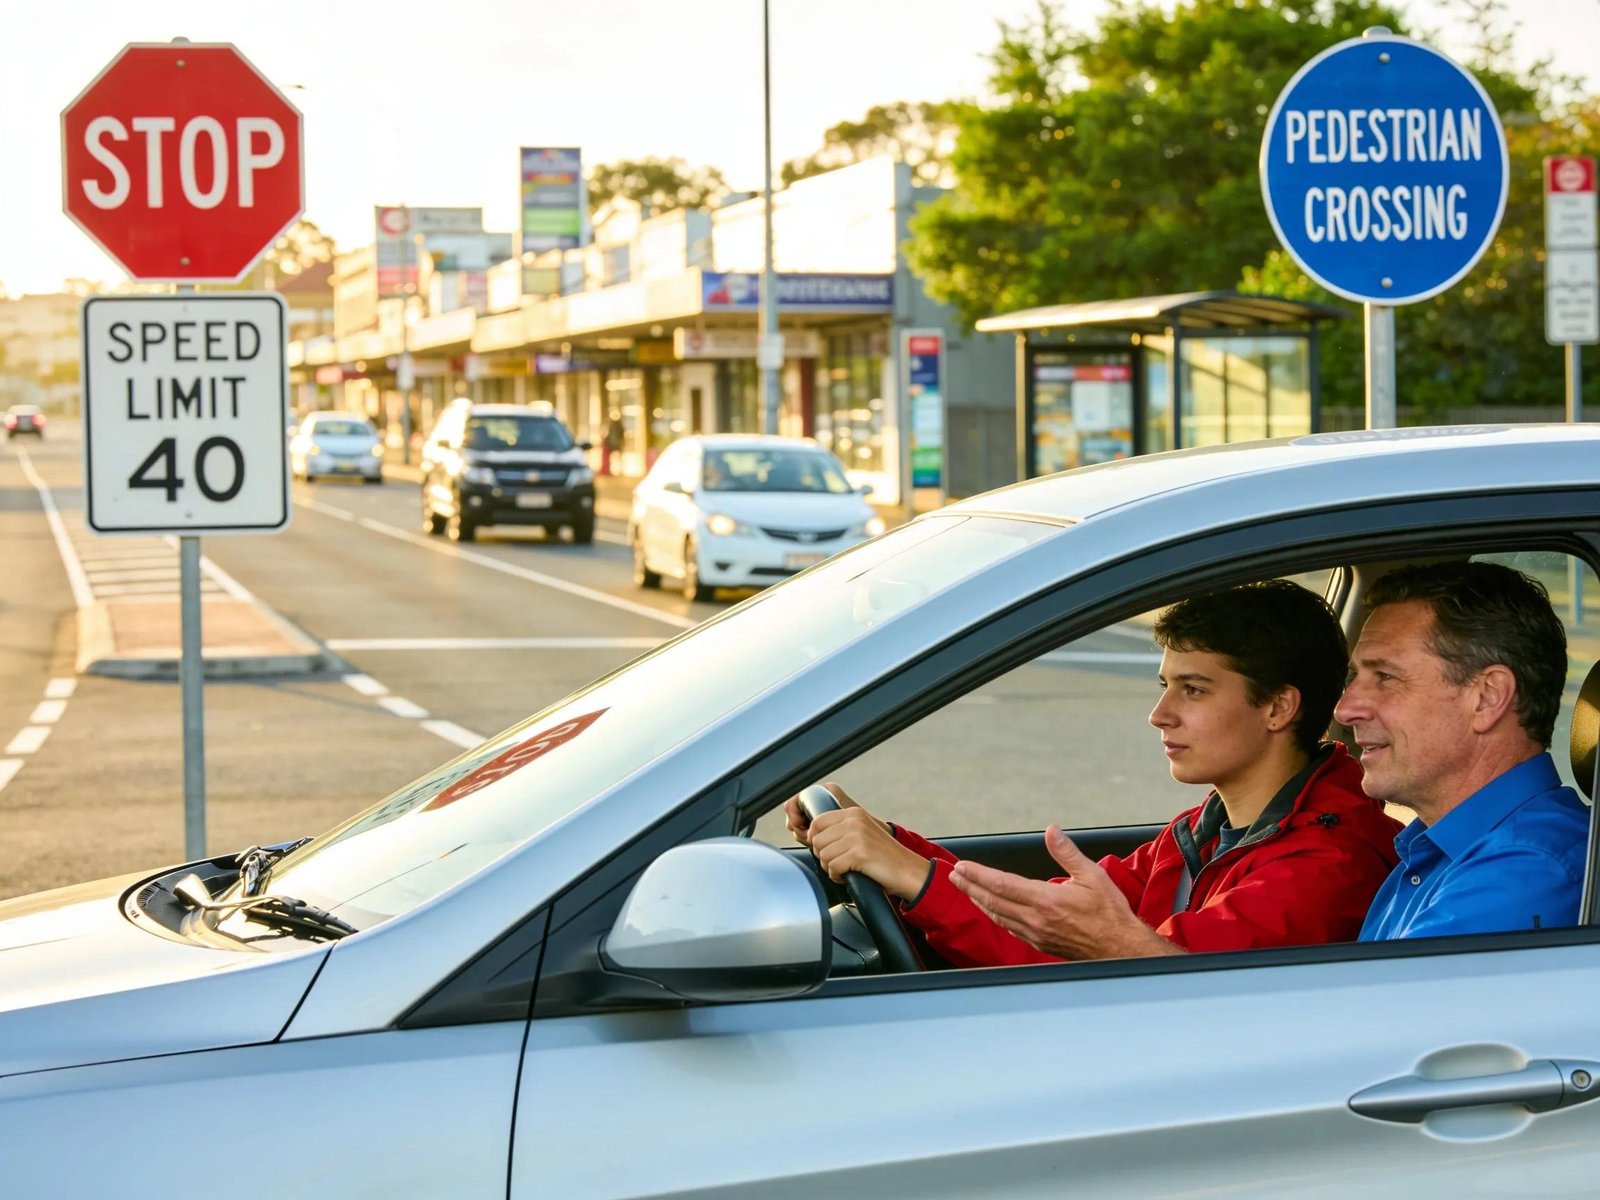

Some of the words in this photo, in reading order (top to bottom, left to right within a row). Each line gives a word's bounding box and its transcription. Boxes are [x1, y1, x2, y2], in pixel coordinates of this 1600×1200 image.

[82, 115, 286, 209] STOP
[1286, 108, 1482, 163] PEDESTRIAN
[1305, 184, 1468, 242] CROSSING
[107, 322, 261, 363] SPEED
[127, 378, 246, 419] LIMIT
[128, 436, 245, 502] 40
